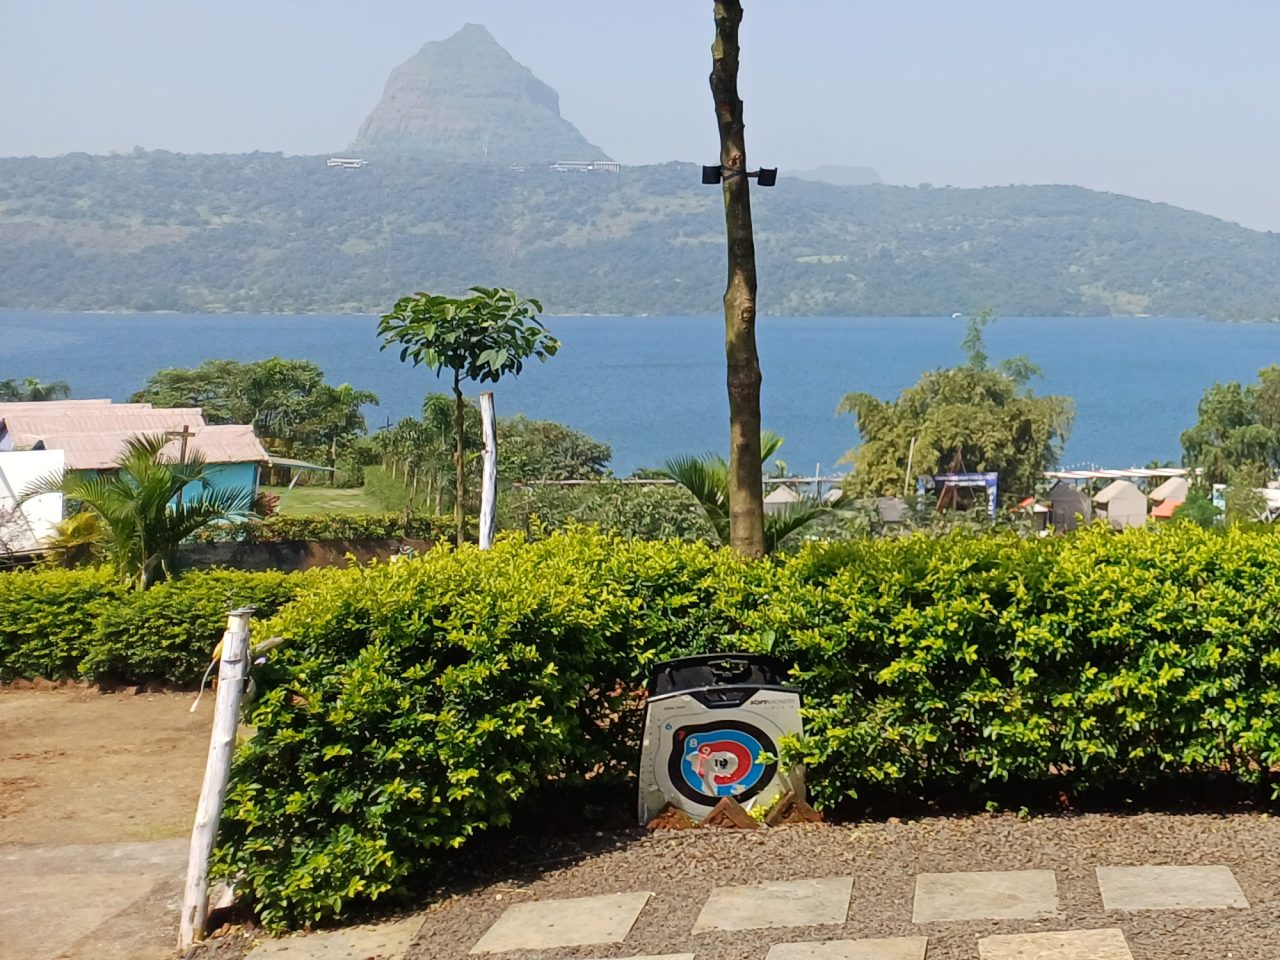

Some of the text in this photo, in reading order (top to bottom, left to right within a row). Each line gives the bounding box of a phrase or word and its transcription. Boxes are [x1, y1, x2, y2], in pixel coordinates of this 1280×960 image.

[665, 722, 672, 730] 6
[678, 730, 686, 740] 7
[690, 738, 697, 748] 8
